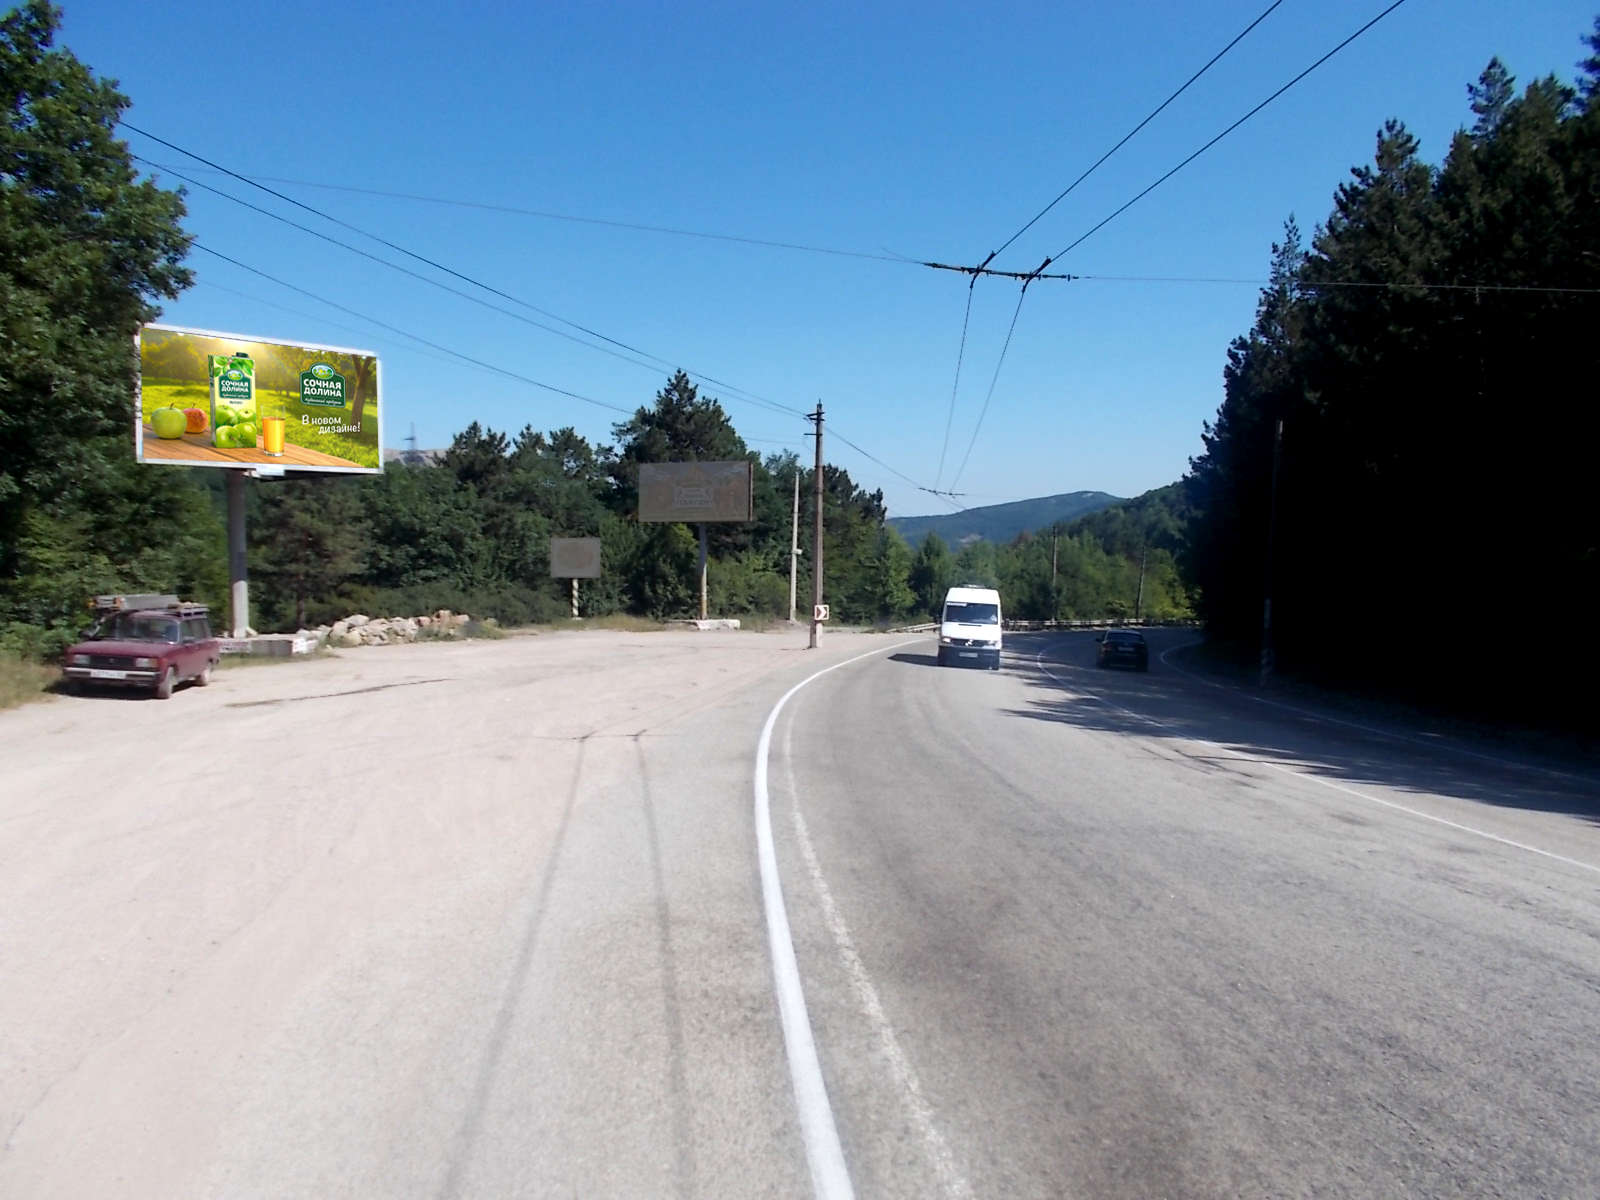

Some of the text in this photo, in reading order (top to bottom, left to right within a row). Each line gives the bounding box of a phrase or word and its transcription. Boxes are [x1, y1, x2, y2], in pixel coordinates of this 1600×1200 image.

[303, 378, 342, 389] СОЧНАЯ
[221, 386, 249, 394] ДОЛИНА
[303, 387, 342, 398] ДОЛИНА
[302, 414, 341, 425] В новом
[318, 421, 361, 435] дизайне!
